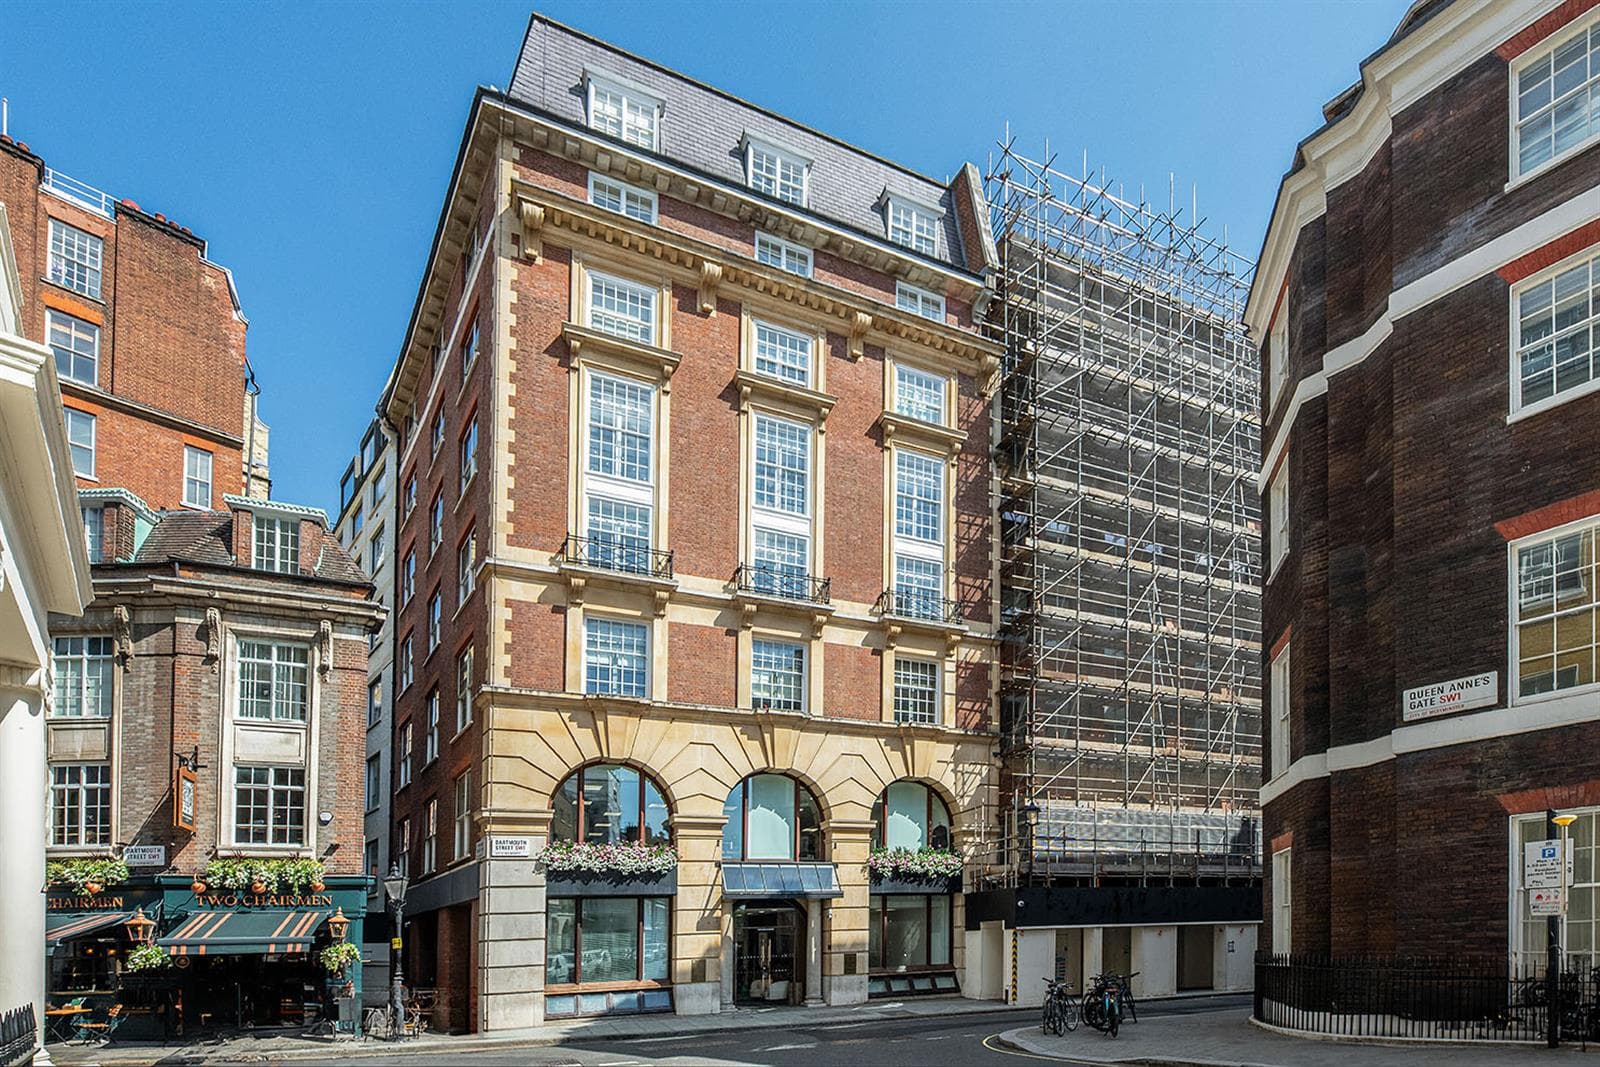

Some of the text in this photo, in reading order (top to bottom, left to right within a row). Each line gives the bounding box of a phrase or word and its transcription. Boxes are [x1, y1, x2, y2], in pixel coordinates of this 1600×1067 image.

[1409, 676, 1490, 701] QUEEN ANNE'S
[1409, 692, 1461, 710] GATE SW1
[195, 894, 333, 907] TWO CHAIRMEN
